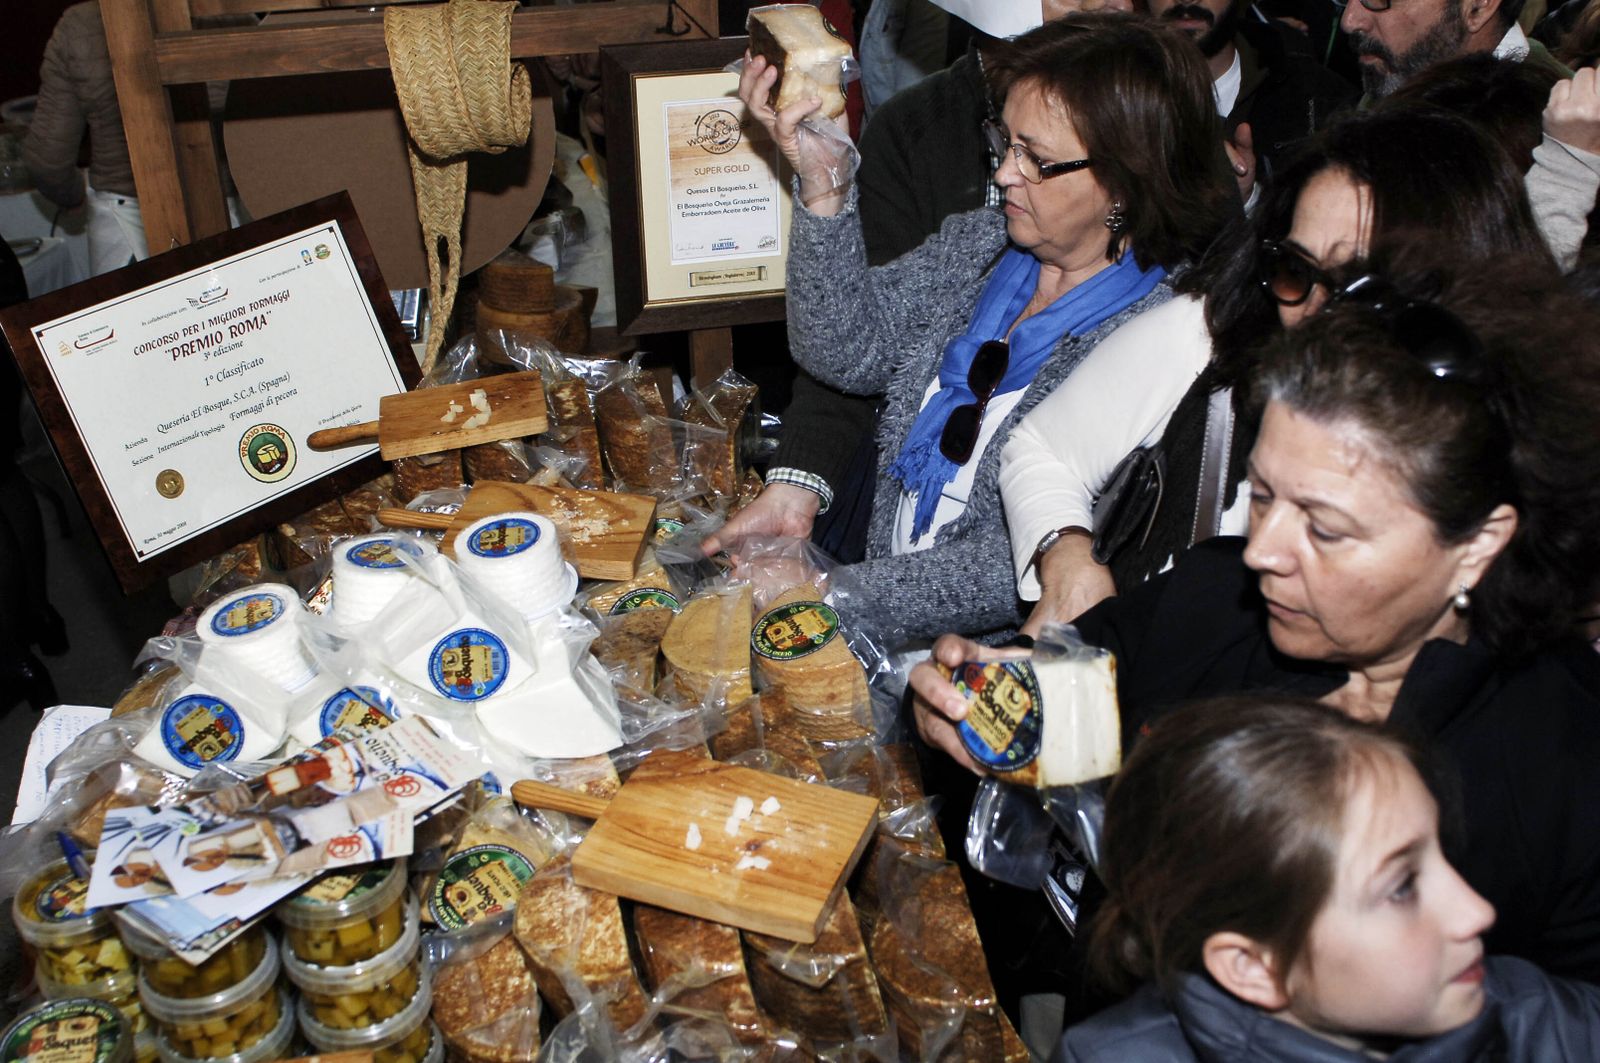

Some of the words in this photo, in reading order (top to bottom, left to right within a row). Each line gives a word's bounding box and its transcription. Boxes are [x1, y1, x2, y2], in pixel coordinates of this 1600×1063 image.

[694, 166, 722, 176] SUPER
[723, 163, 750, 174] GOLD
[686, 187, 709, 196] Quesos
[748, 183, 759, 191] S.L.
[714, 199, 732, 209] Oveja
[751, 204, 766, 212] Oliva
[182, 323, 199, 339] PER
[208, 304, 246, 329] MIGLIORI
[249, 289, 290, 315] FORMAGGI
[213, 338, 244, 359] edizione
[216, 356, 265, 384] Classificato
[124, 436, 149, 452] Azienda
[156, 413, 191, 435] Queseria
[190, 406, 202, 420] El
[202, 396, 233, 415] Bosque,
[233, 385, 257, 403] S.C.A.
[258, 371, 291, 394] (Spagna)
[131, 453, 155, 467] Sezione
[157, 429, 200, 455] Internazionale
[200, 423, 226, 439] Tipologia
[229, 400, 265, 422] Formaggi
[265, 395, 274, 407] di
[274, 387, 298, 406] pecora
[241, 428, 260, 458] PREMIO
[260, 425, 286, 440] ROMA
